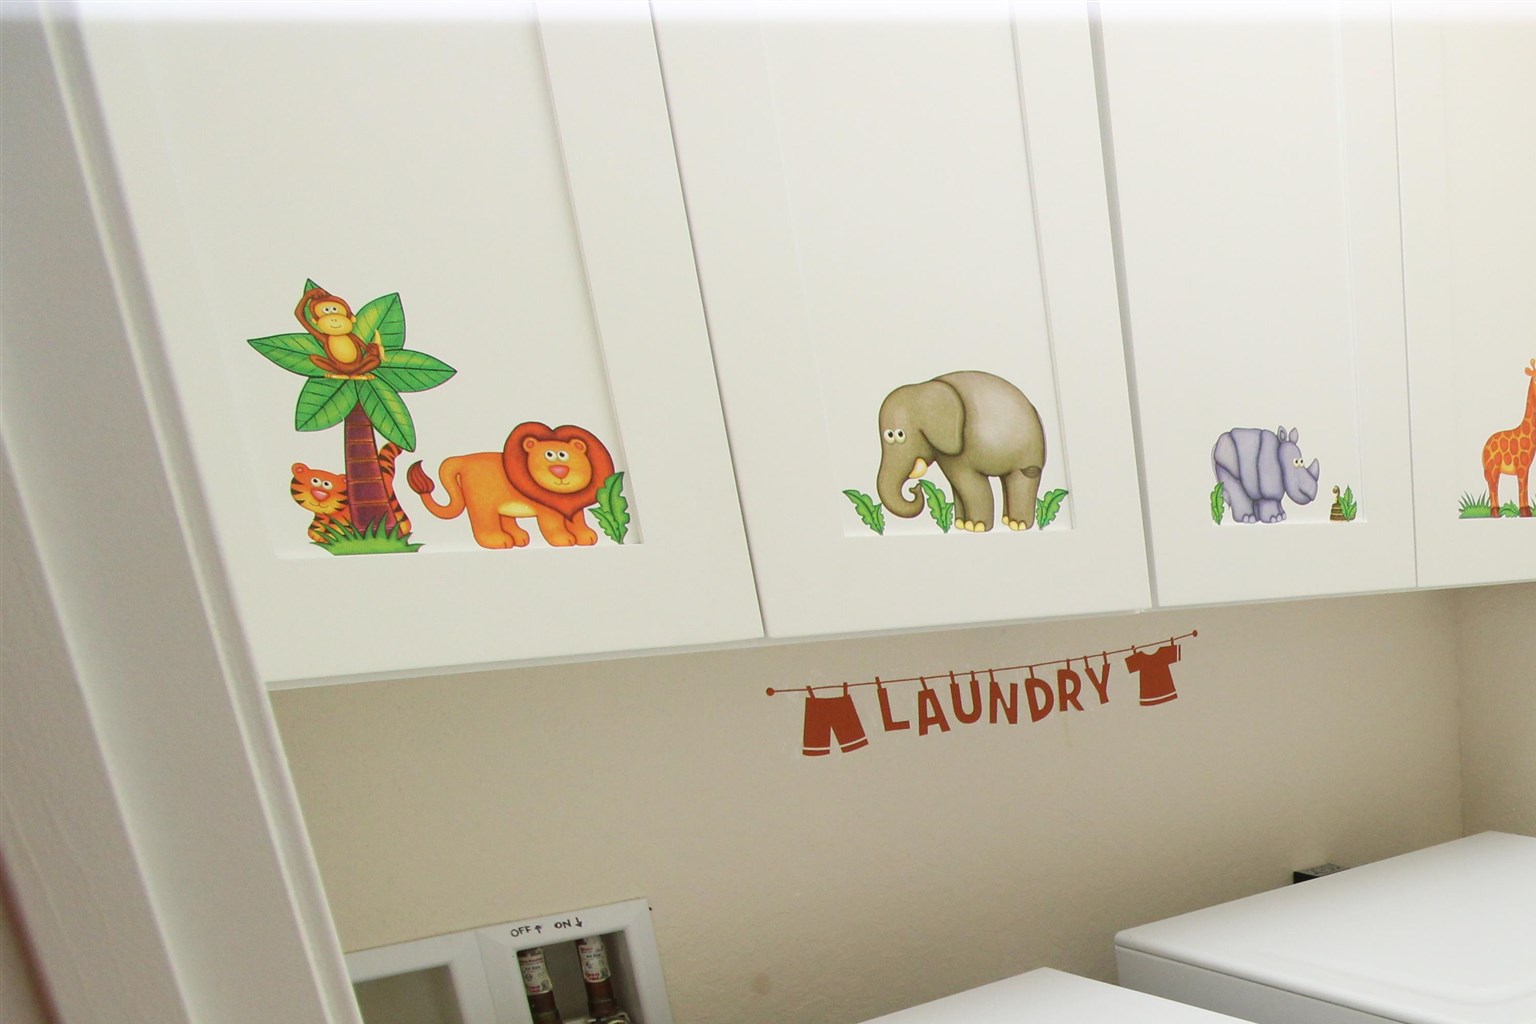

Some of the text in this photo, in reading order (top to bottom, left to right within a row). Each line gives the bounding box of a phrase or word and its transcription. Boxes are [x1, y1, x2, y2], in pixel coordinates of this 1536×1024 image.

[876, 662, 1111, 736] LAUNDRY
[510, 919, 572, 938] OFF ON
